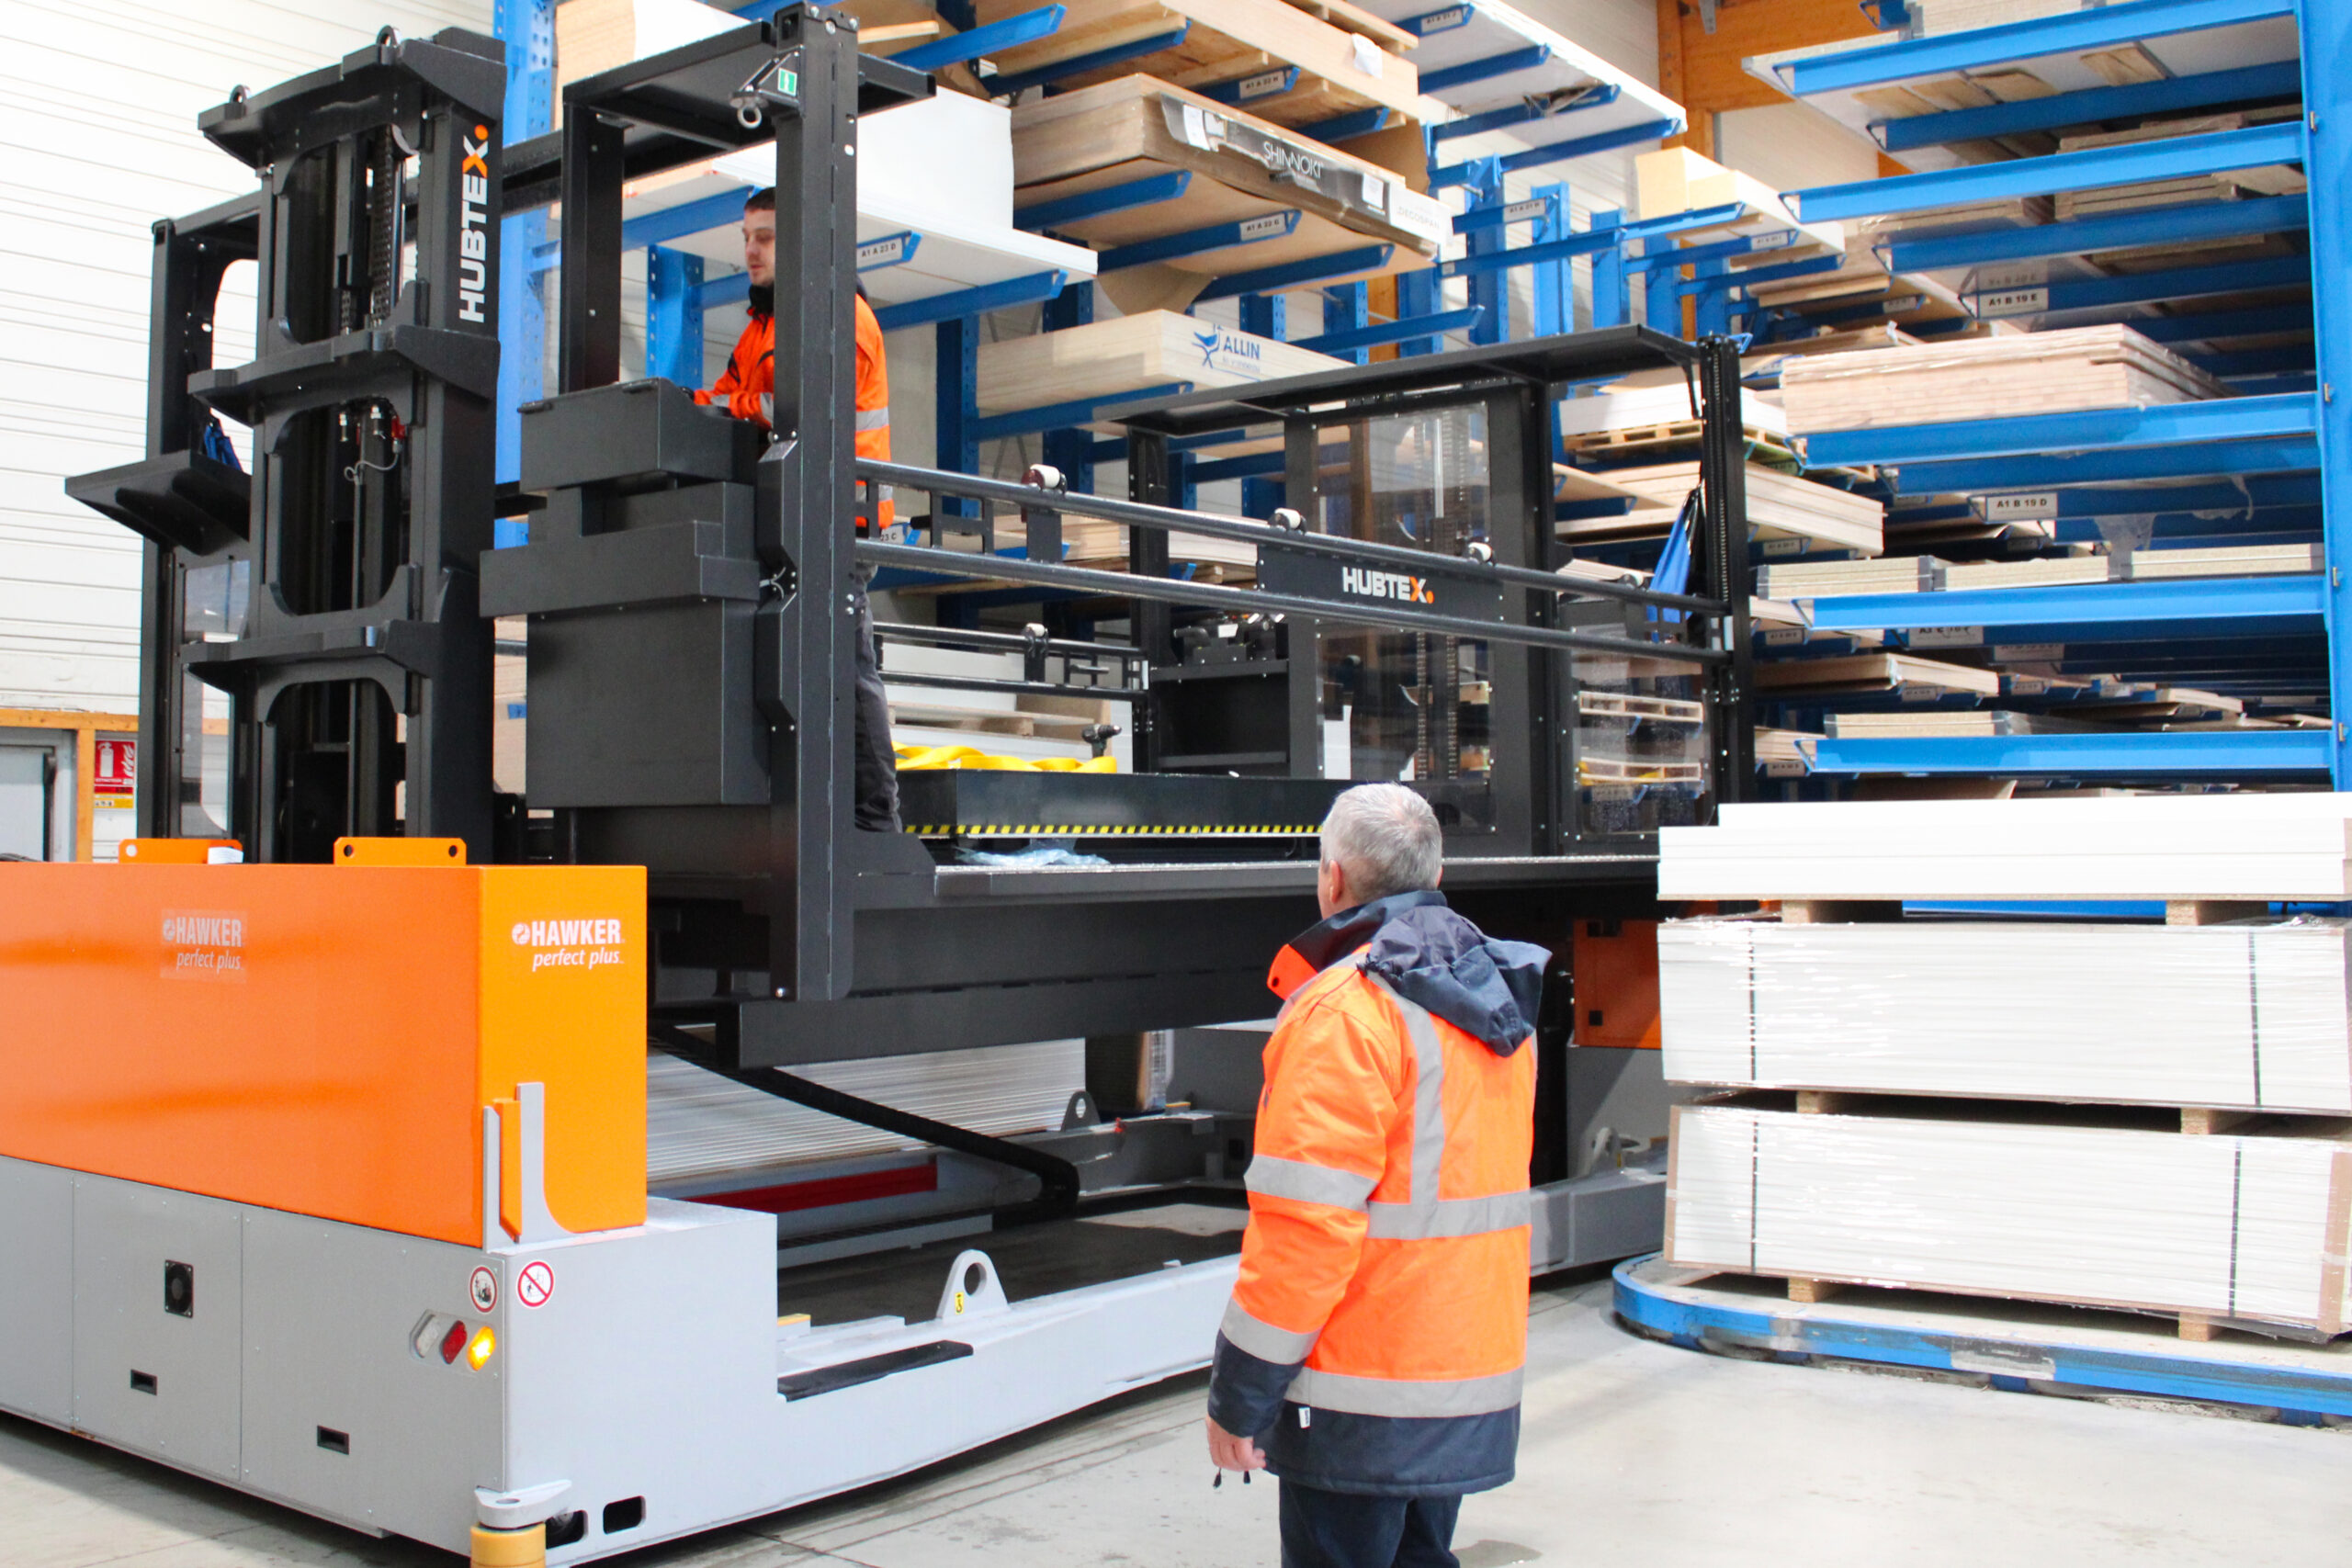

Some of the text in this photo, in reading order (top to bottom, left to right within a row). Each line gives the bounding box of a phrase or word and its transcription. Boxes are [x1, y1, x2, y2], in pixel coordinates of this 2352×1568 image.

[1263, 141, 1322, 179] SHINNOKI
[862, 249, 870, 257] A1
[1989, 298, 2001, 307] A1
[2006, 296, 2012, 304] B
[2031, 293, 2037, 301] E
[1223, 335, 1260, 360] ALLIN
[1996, 500, 2009, 508] A1
[2025, 499, 2037, 507] 19
[2040, 498, 2047, 506] D
[890, 532, 898, 541] C
[175, 916, 243, 948] HAWKER
[532, 919, 622, 947] HAWKER
[176, 947, 242, 975] perfect plus
[532, 946, 621, 973] perfect plus
